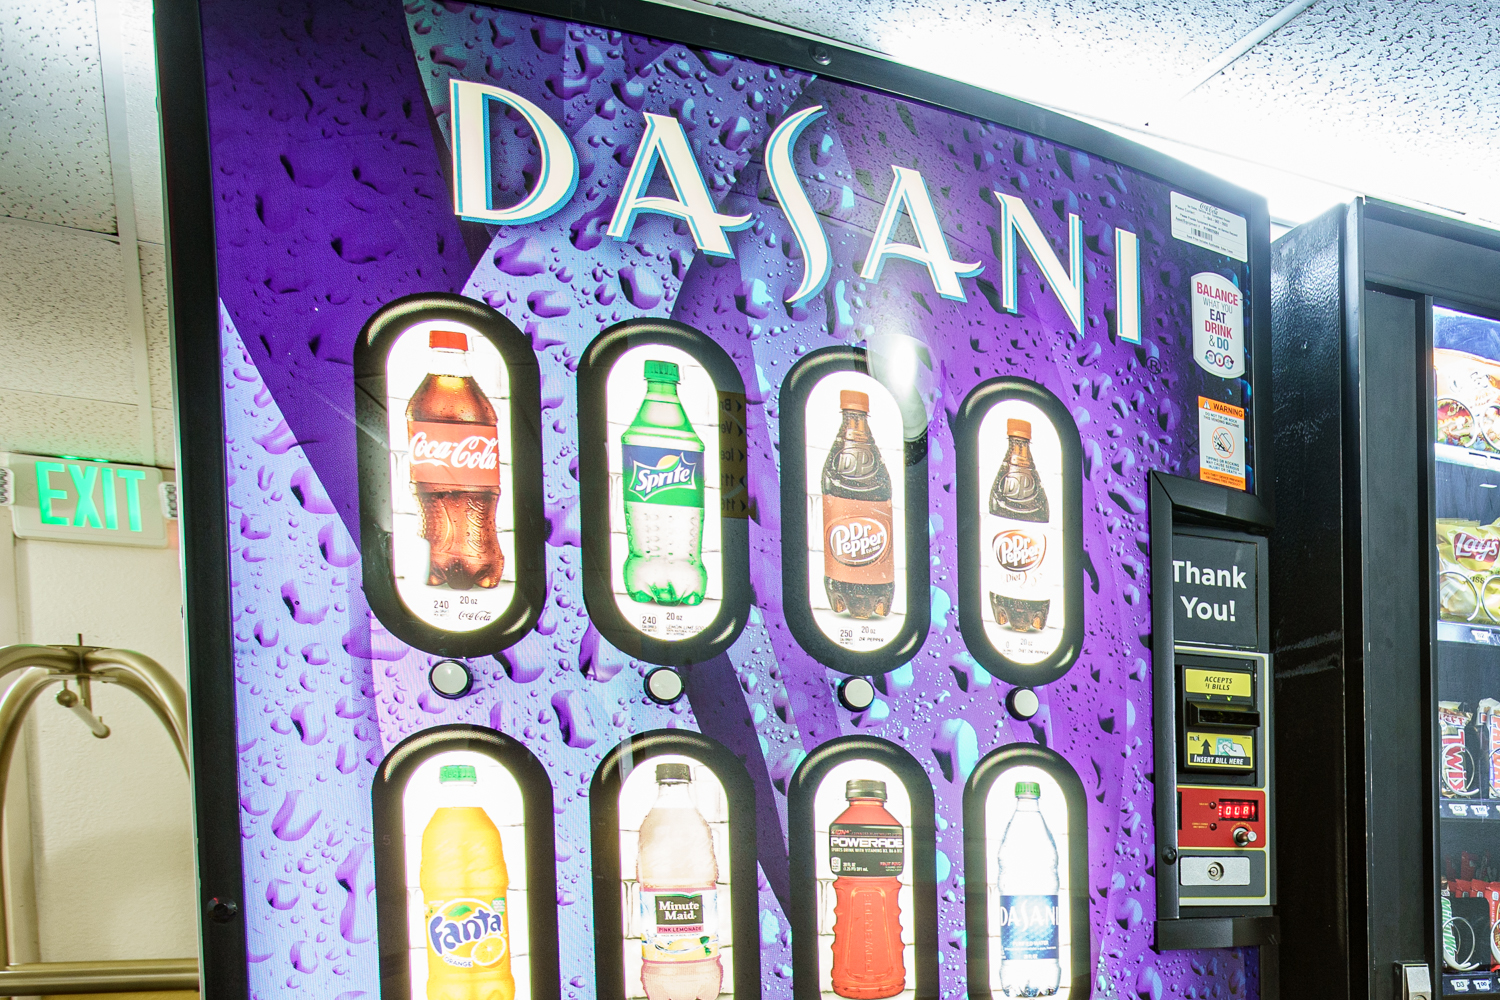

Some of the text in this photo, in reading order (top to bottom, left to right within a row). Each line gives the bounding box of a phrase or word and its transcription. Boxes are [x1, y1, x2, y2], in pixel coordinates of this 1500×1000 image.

[450, 79, 1141, 346] DASANI
[1197, 281, 1238, 306] BALANCE
[1203, 297, 1233, 314] WHAT YOU
[1204, 320, 1233, 340] DRINK
[1209, 334, 1229, 351] & DO
[1213, 402, 1243, 418] WARNING
[409, 431, 499, 470] Coca-Cola
[636, 463, 691, 494] Sprite
[35, 461, 146, 533] EXIT
[849, 522, 872, 541] Dr
[830, 525, 884, 558] Pepper
[1015, 534, 1032, 550] Dr
[1455, 532, 1500, 562] Lay's
[1000, 536, 1040, 567] Pepper
[1005, 572, 1022, 584] Diet
[1173, 560, 1247, 590] Thank
[434, 599, 449, 610] 240
[460, 595, 470, 605] 20
[458, 610, 492, 621] Coca-Cola
[666, 612, 675, 621] 20
[1180, 596, 1236, 622] You!
[642, 615, 657, 625] 240
[840, 629, 853, 638] 250
[861, 625, 869, 634] 20
[1020, 638, 1028, 646] 20
[1204, 676, 1233, 684] ACCEPTS
[1193, 754, 1214, 764] INSERT
[830, 837, 904, 848] POWERADE
[658, 900, 700, 911] Minute
[664, 910, 696, 921] Maid
[1000, 900, 1059, 932] DASANI
[429, 909, 502, 955] Fanta
[443, 956, 473, 968] ORANGE
